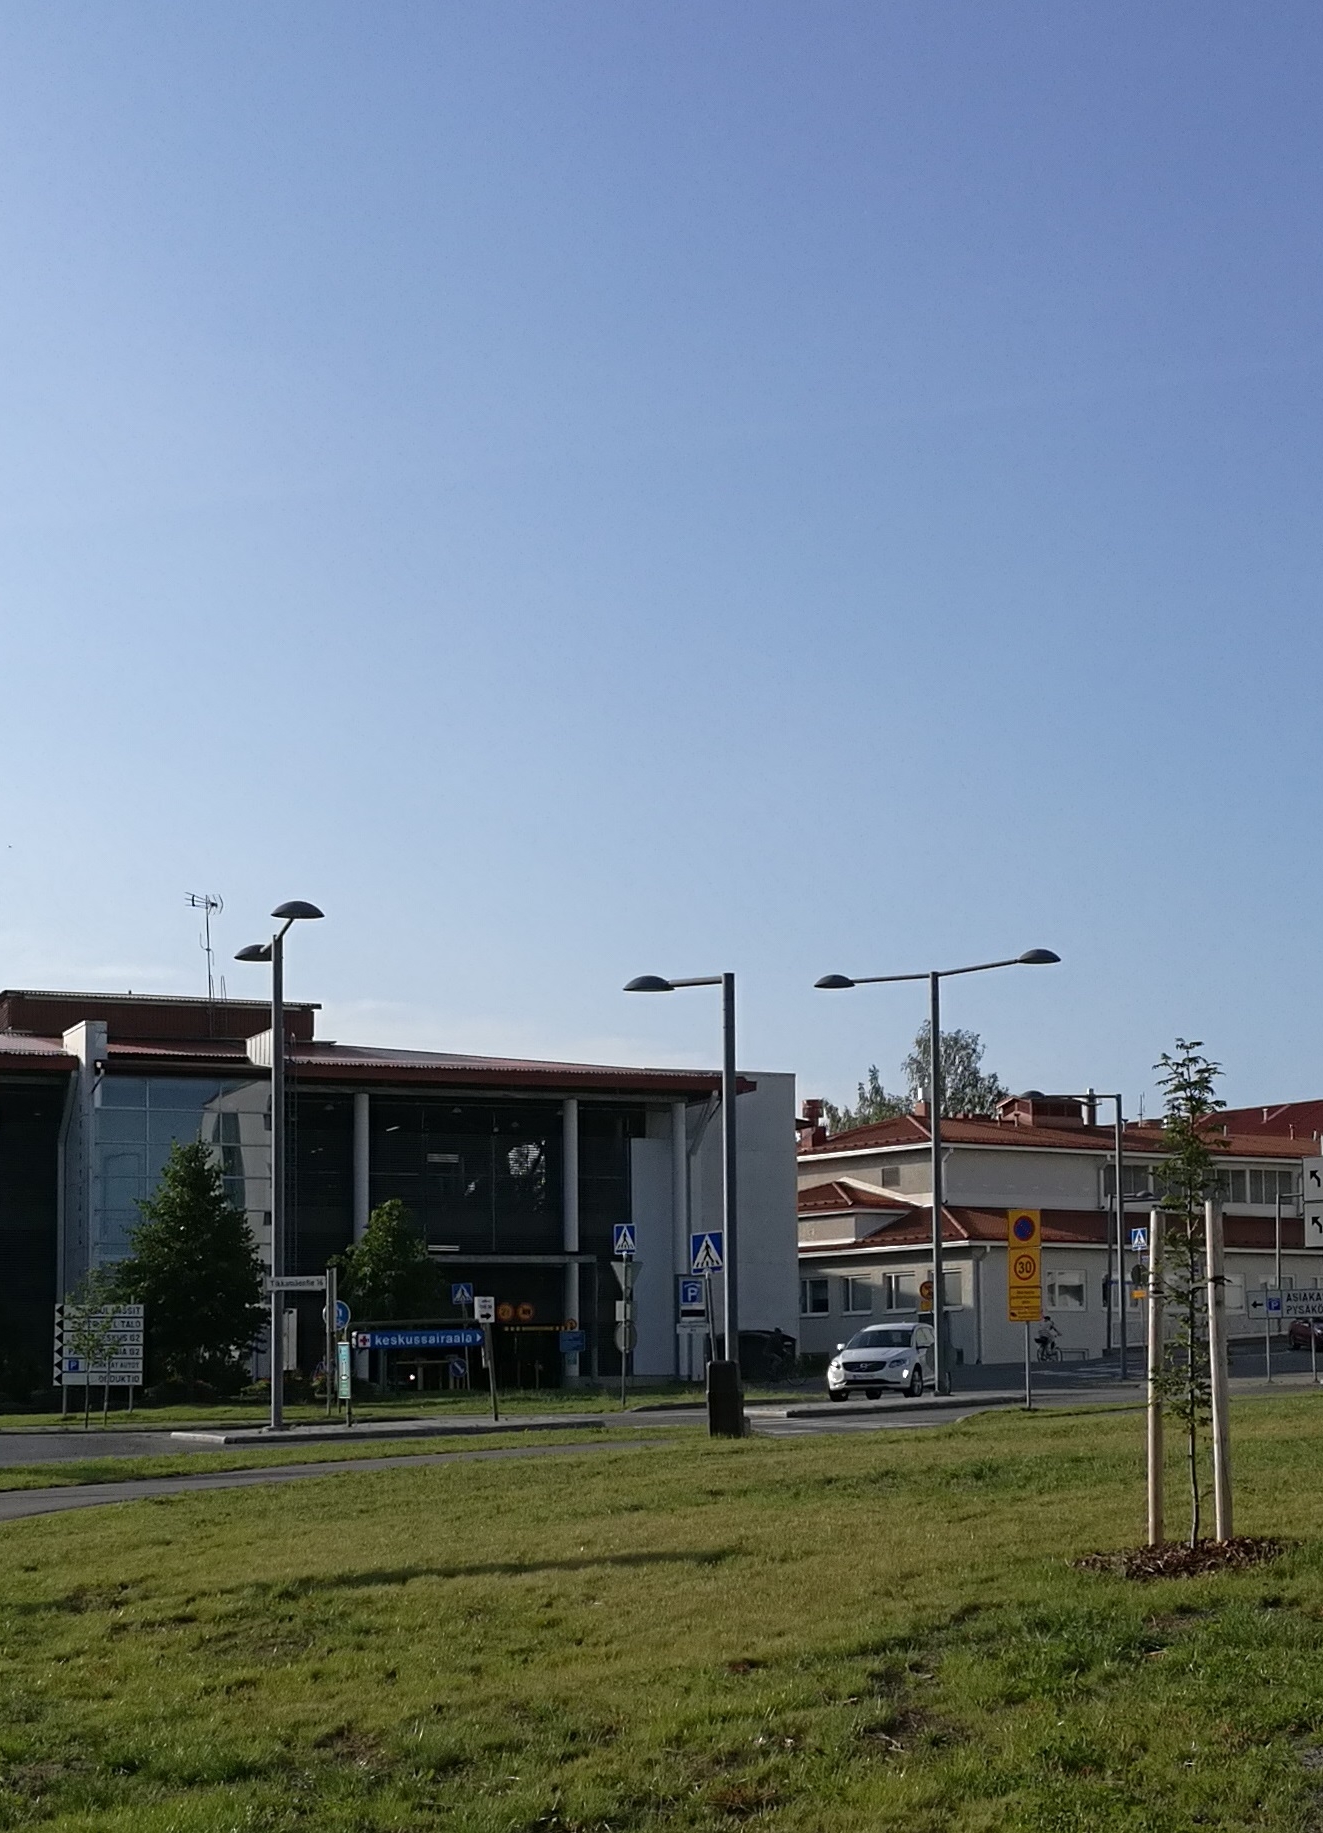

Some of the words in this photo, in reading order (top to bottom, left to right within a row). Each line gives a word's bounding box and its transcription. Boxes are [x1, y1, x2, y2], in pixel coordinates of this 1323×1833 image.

[1018, 1262, 1032, 1274] 30
[688, 1287, 698, 1302] P
[374, 1333, 473, 1345] keskussairaala
